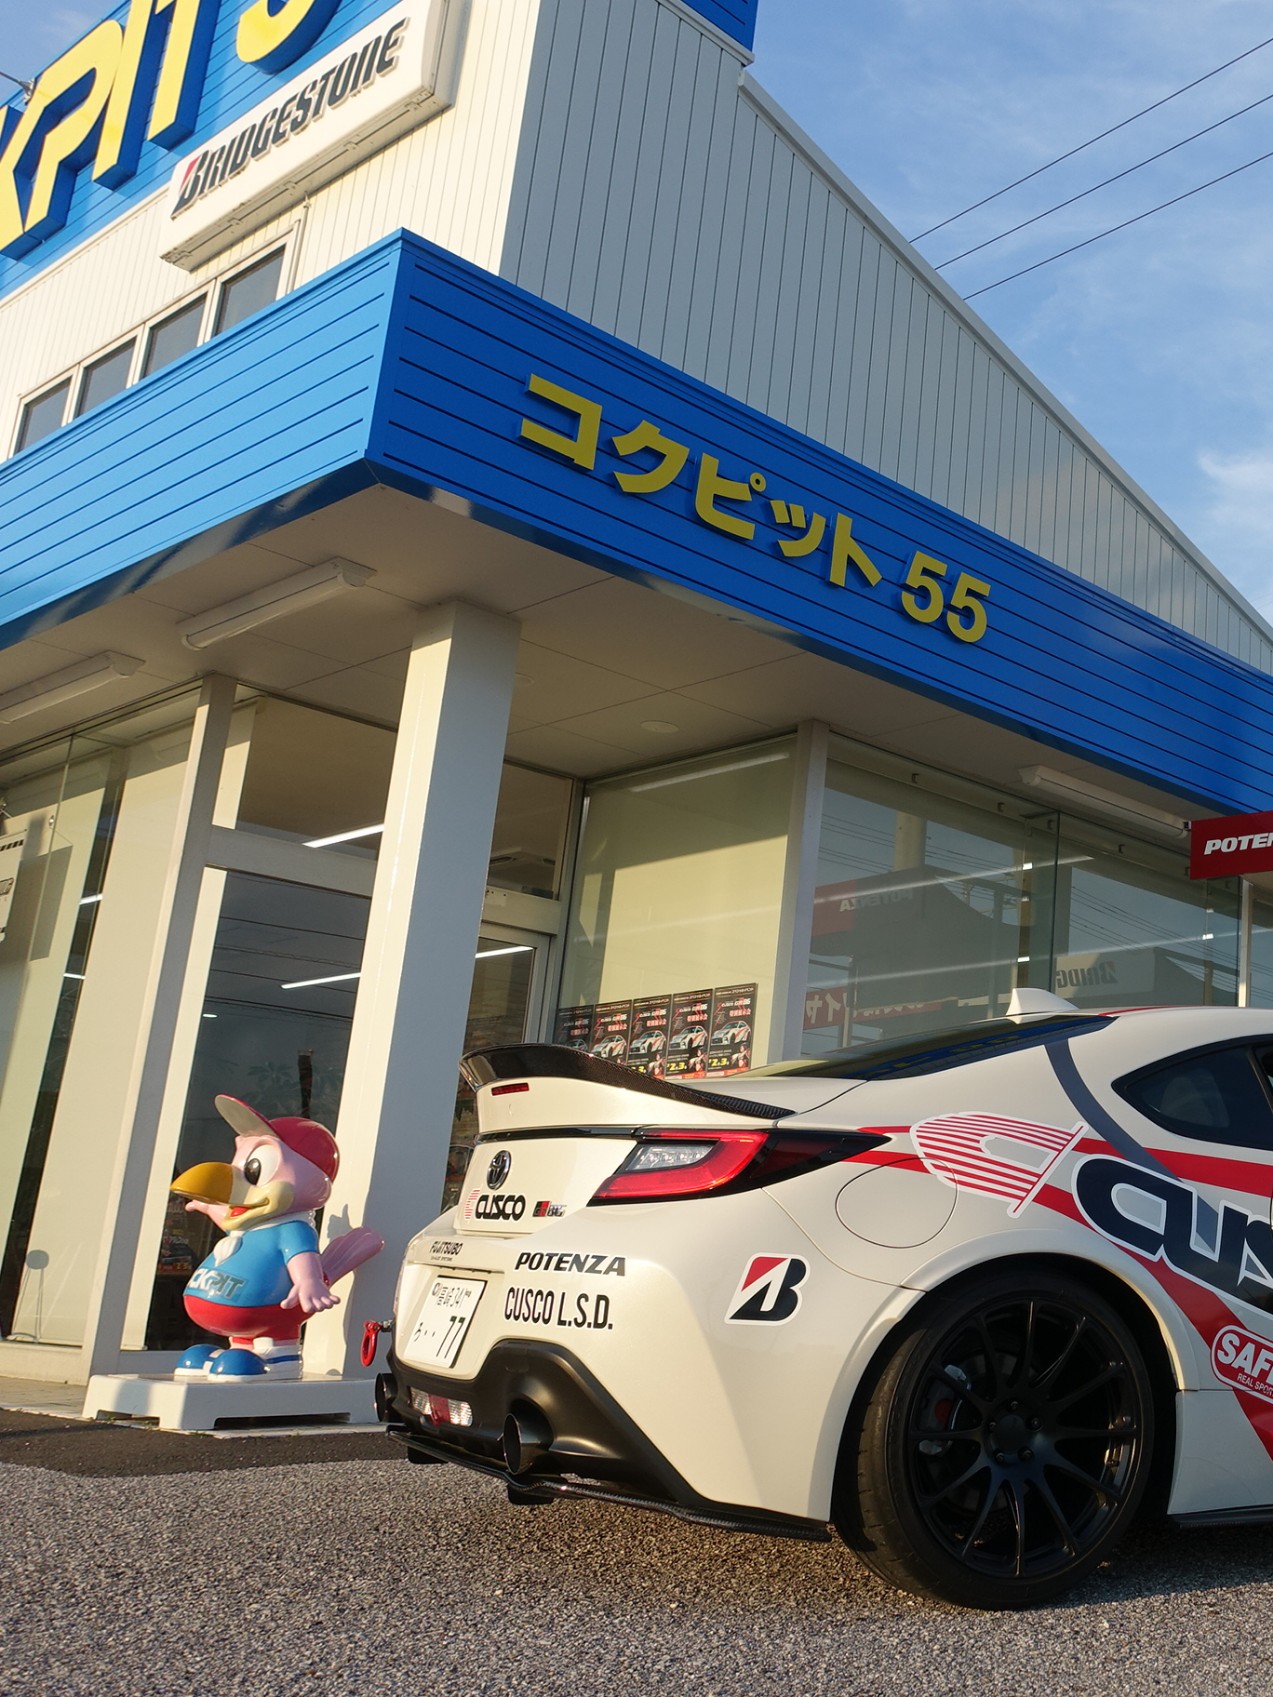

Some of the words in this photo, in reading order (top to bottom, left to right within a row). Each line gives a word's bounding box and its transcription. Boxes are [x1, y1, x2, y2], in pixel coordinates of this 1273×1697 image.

[170, 17, 408, 219] BRIDGESTONE
[520, 373, 883, 588] コクピット
[900, 550, 992, 643] 55
[429, 1240, 464, 1256] FUJITSUBO
[515, 1251, 626, 1277] POTENZA
[504, 1286, 555, 1325] CUSCO
[556, 1291, 613, 1330] L.S.D.
[1236, 1372, 1254, 1388] REAL
